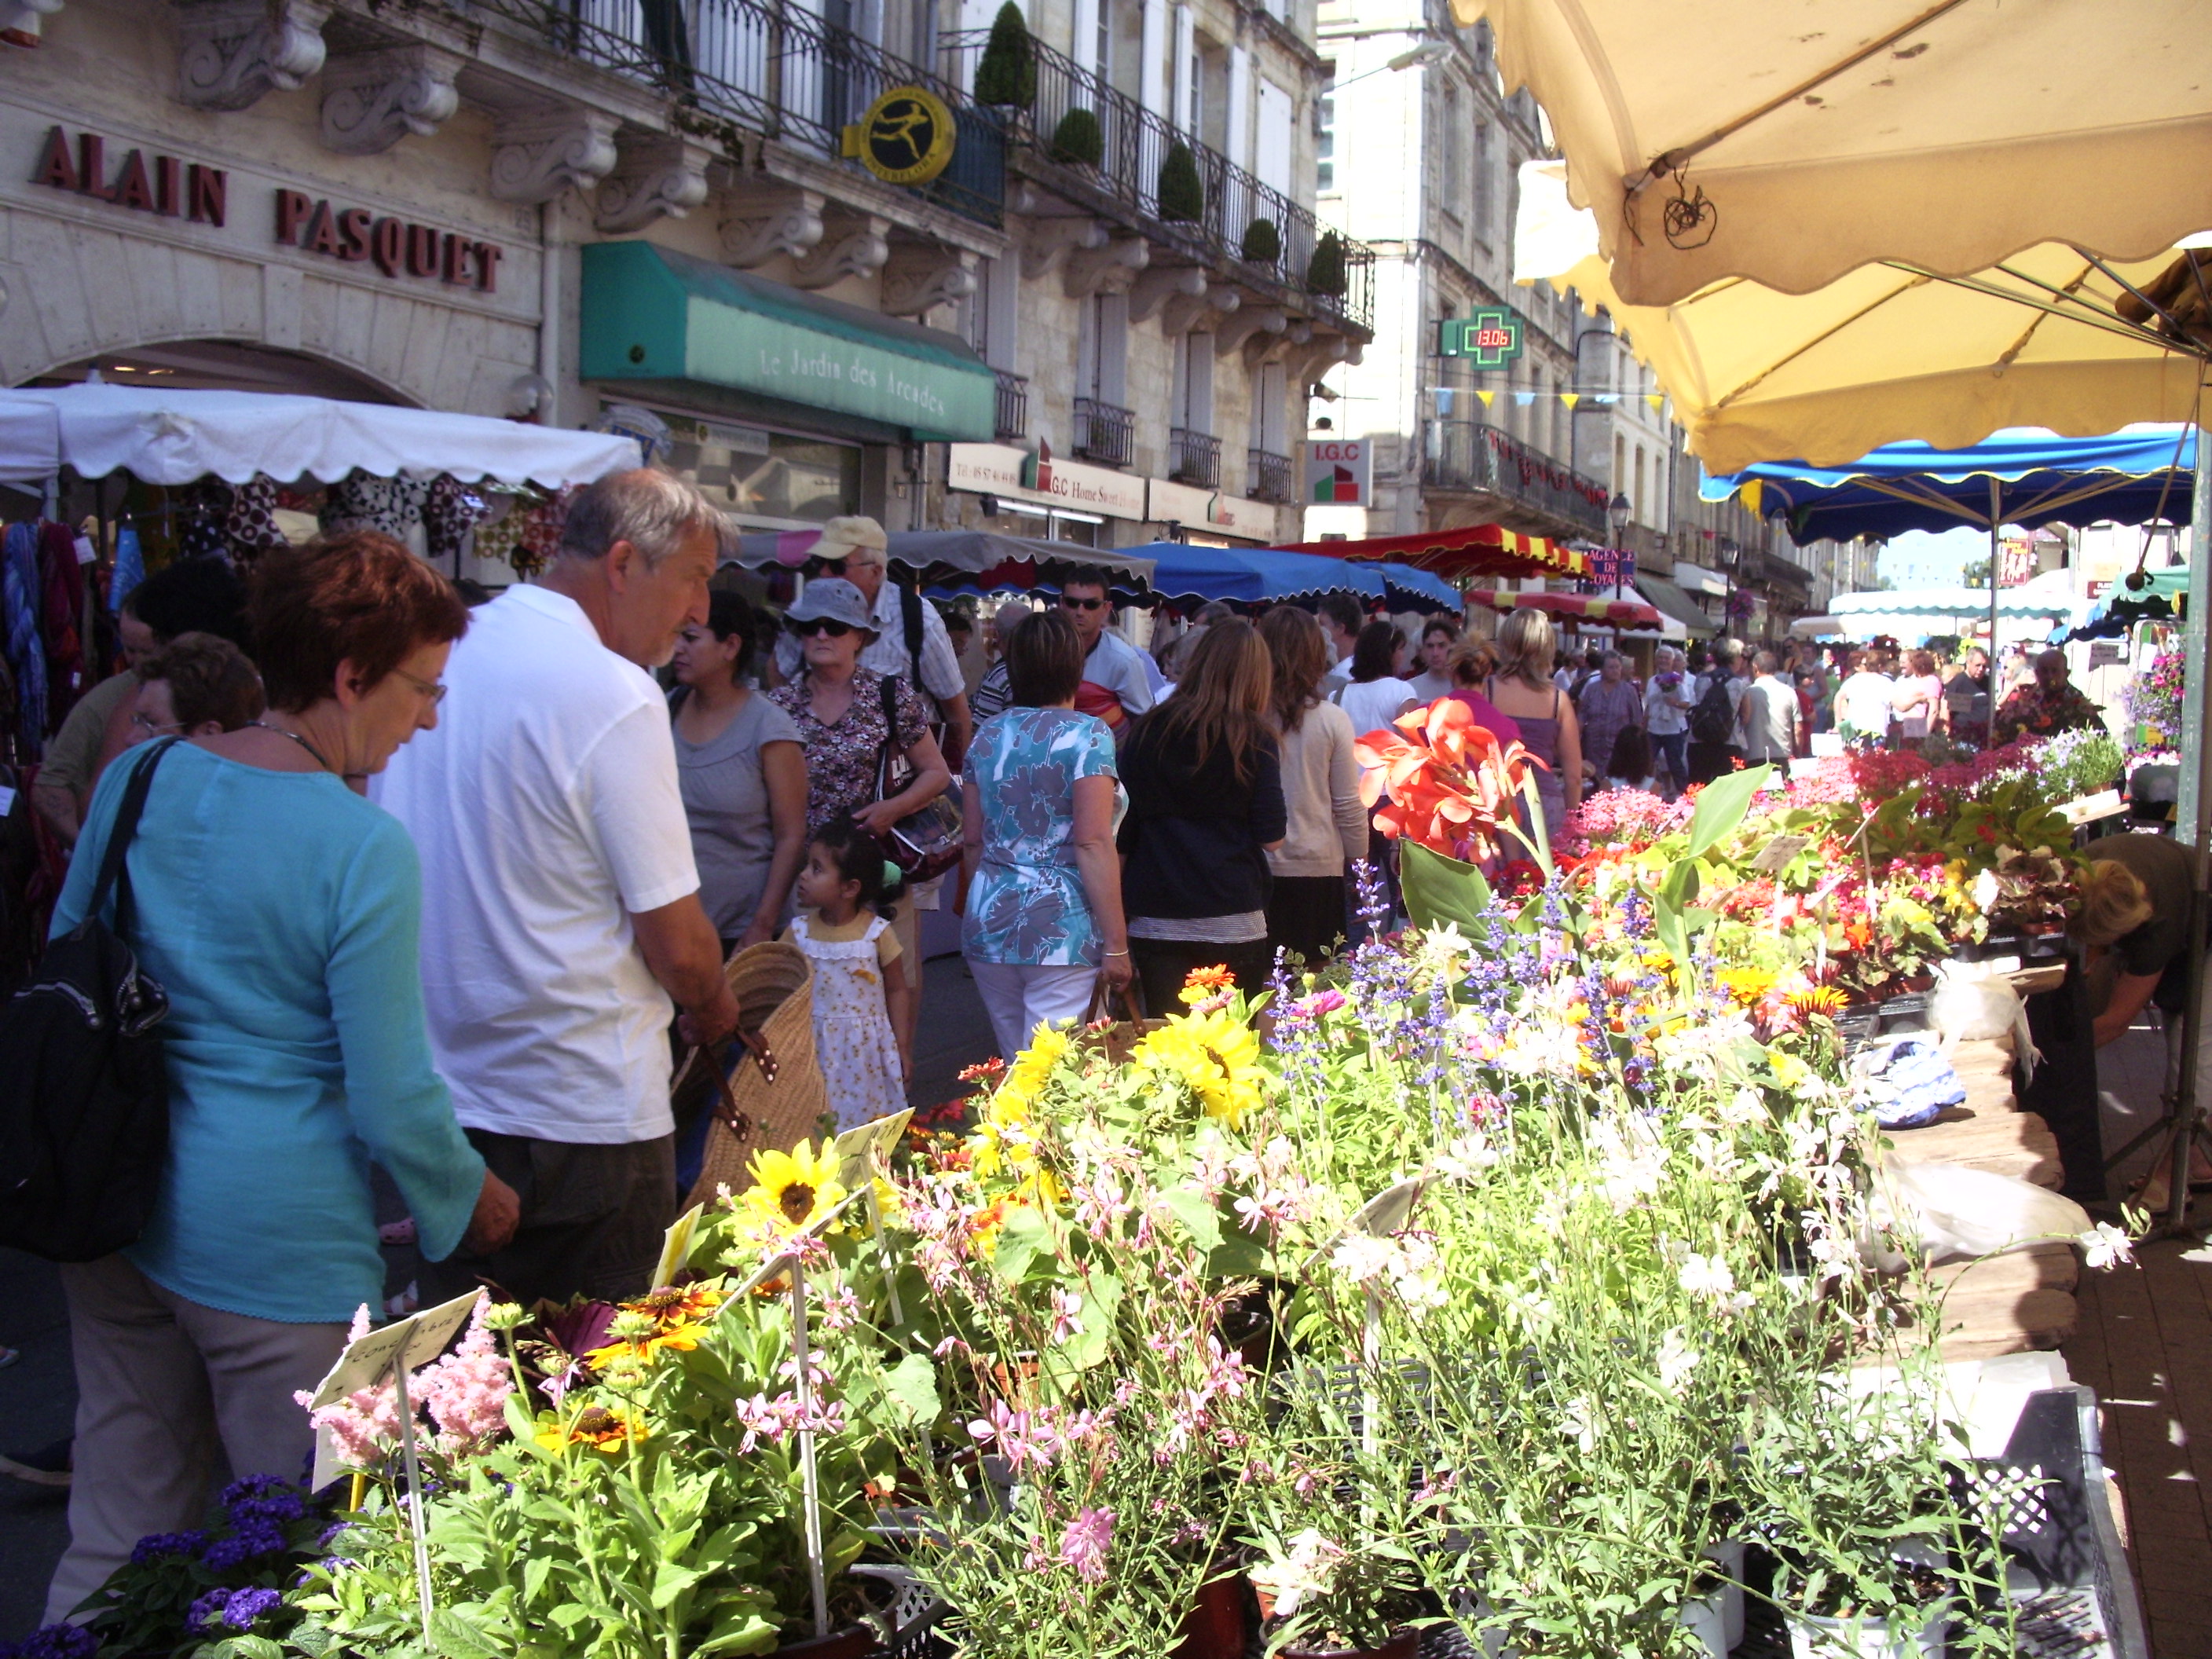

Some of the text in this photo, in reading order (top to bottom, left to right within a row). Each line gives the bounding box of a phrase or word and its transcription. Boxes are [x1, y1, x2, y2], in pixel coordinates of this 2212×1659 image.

[28, 125, 502, 292] ALAIN PASQUET
[760, 349, 945, 416] Le Jardin des Arcades
[1315, 443, 1360, 461] I.G.C
[1072, 482, 1097, 502] Home
[1098, 486, 1119, 506] Sweet
[1604, 562, 1618, 573] DE
[1588, 574, 1634, 585] OYAES
